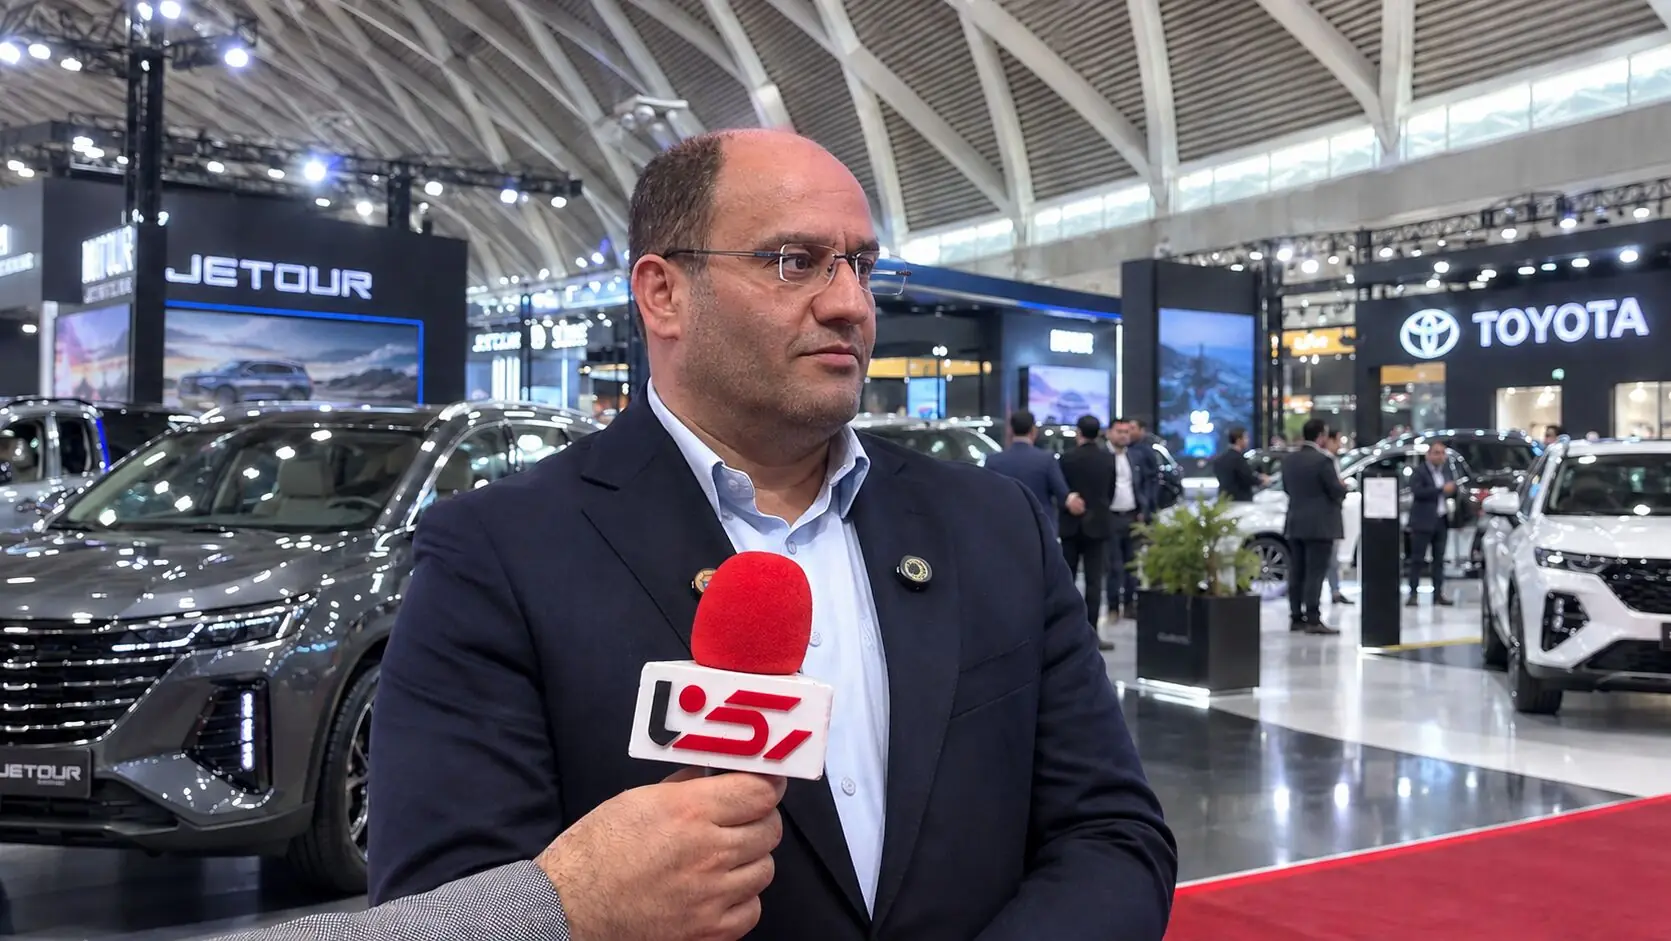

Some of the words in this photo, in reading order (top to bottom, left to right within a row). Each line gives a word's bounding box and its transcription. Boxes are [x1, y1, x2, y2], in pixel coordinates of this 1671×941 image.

[165, 253, 373, 300] JETOUR
[1471, 297, 1650, 348] TOYOTA
[0, 763, 82, 781] JETOUR
